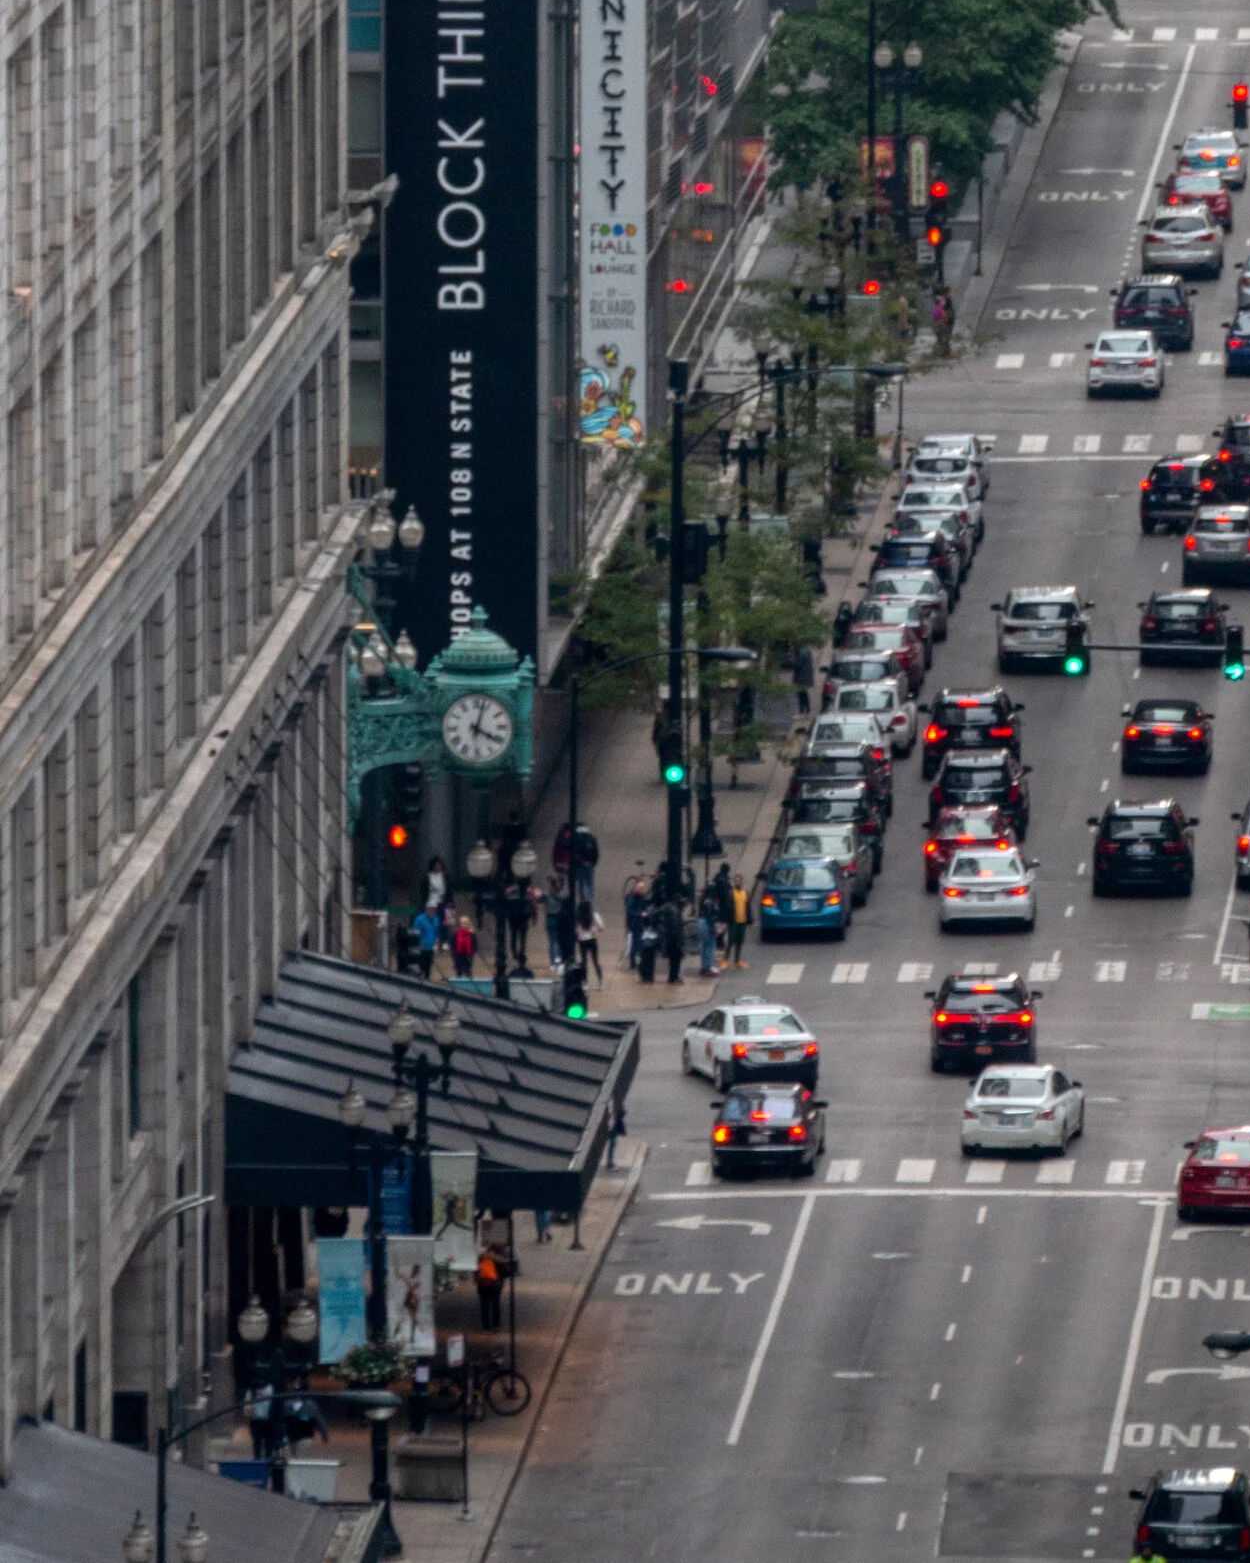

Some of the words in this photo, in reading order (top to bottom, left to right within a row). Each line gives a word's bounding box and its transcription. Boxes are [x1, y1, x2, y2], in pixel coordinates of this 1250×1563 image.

[1078, 82, 1167, 93] ONLY
[1037, 190, 1132, 202] ONLY
[437, 118, 485, 310] BLOCK
[590, 240, 637, 254] HALL
[995, 308, 1097, 321] ONLY
[450, 349, 473, 432] STATE
[450, 442, 473, 459] N
[450, 468, 473, 517] 108
[450, 528, 473, 561] AT
[450, 571, 473, 641] HOPS
[615, 1272, 765, 1295] ONLY
